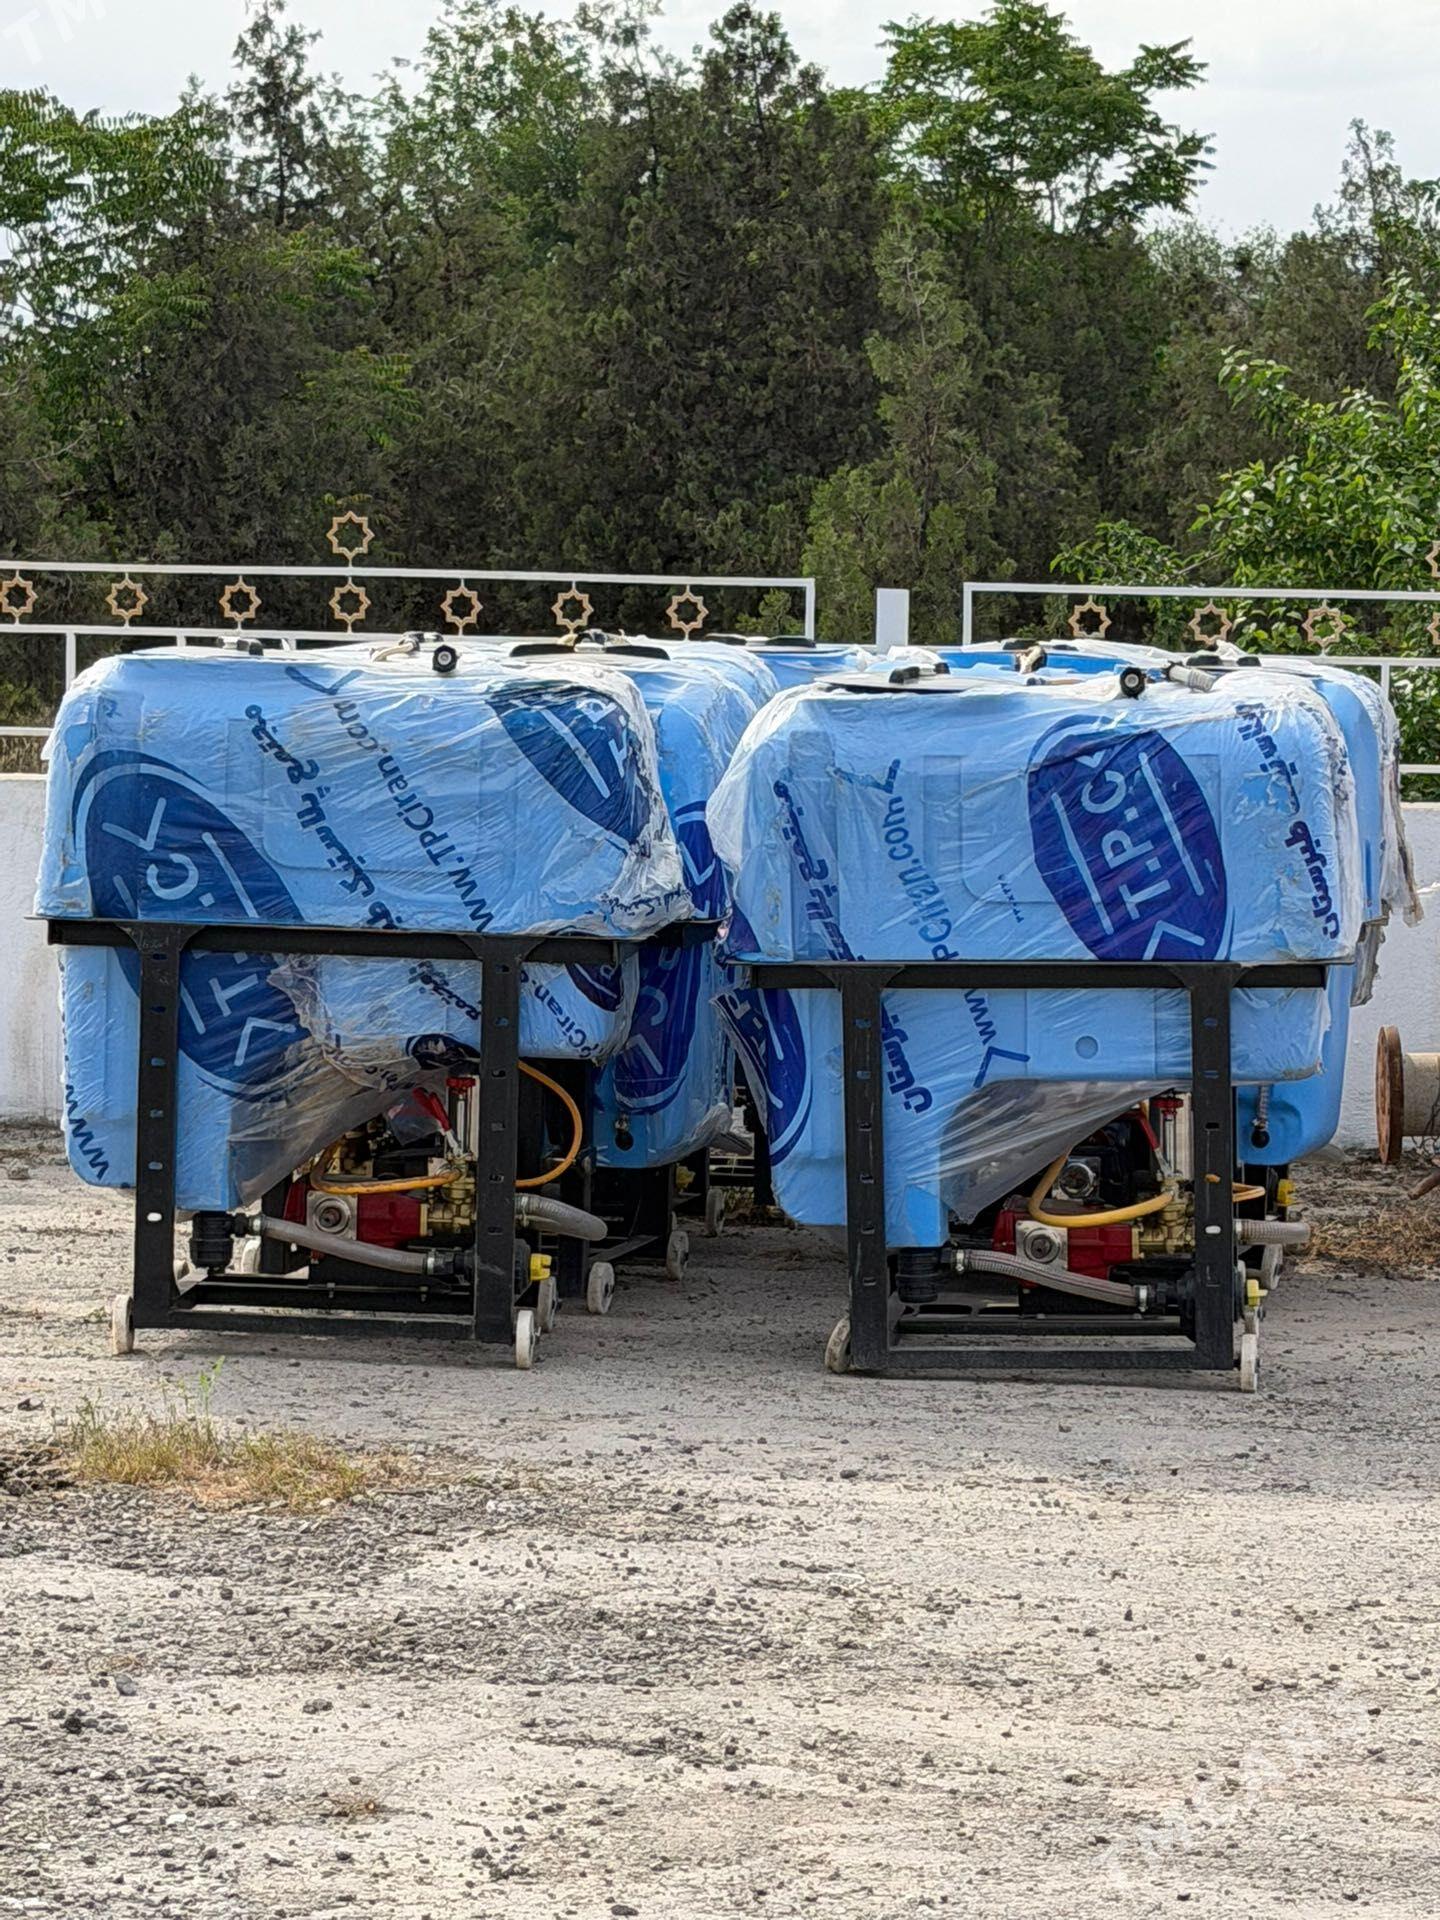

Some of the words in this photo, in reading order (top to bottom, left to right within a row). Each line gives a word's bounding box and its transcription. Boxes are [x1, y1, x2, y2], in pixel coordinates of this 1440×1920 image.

[245, 703, 320, 785] مجتمع
[296, 785, 376, 898] پلاستیک
[334, 700, 495, 933] ww.TPCiran.com
[1080, 769, 1172, 921] T.P.C
[1285, 820, 1341, 940] طبرستان
